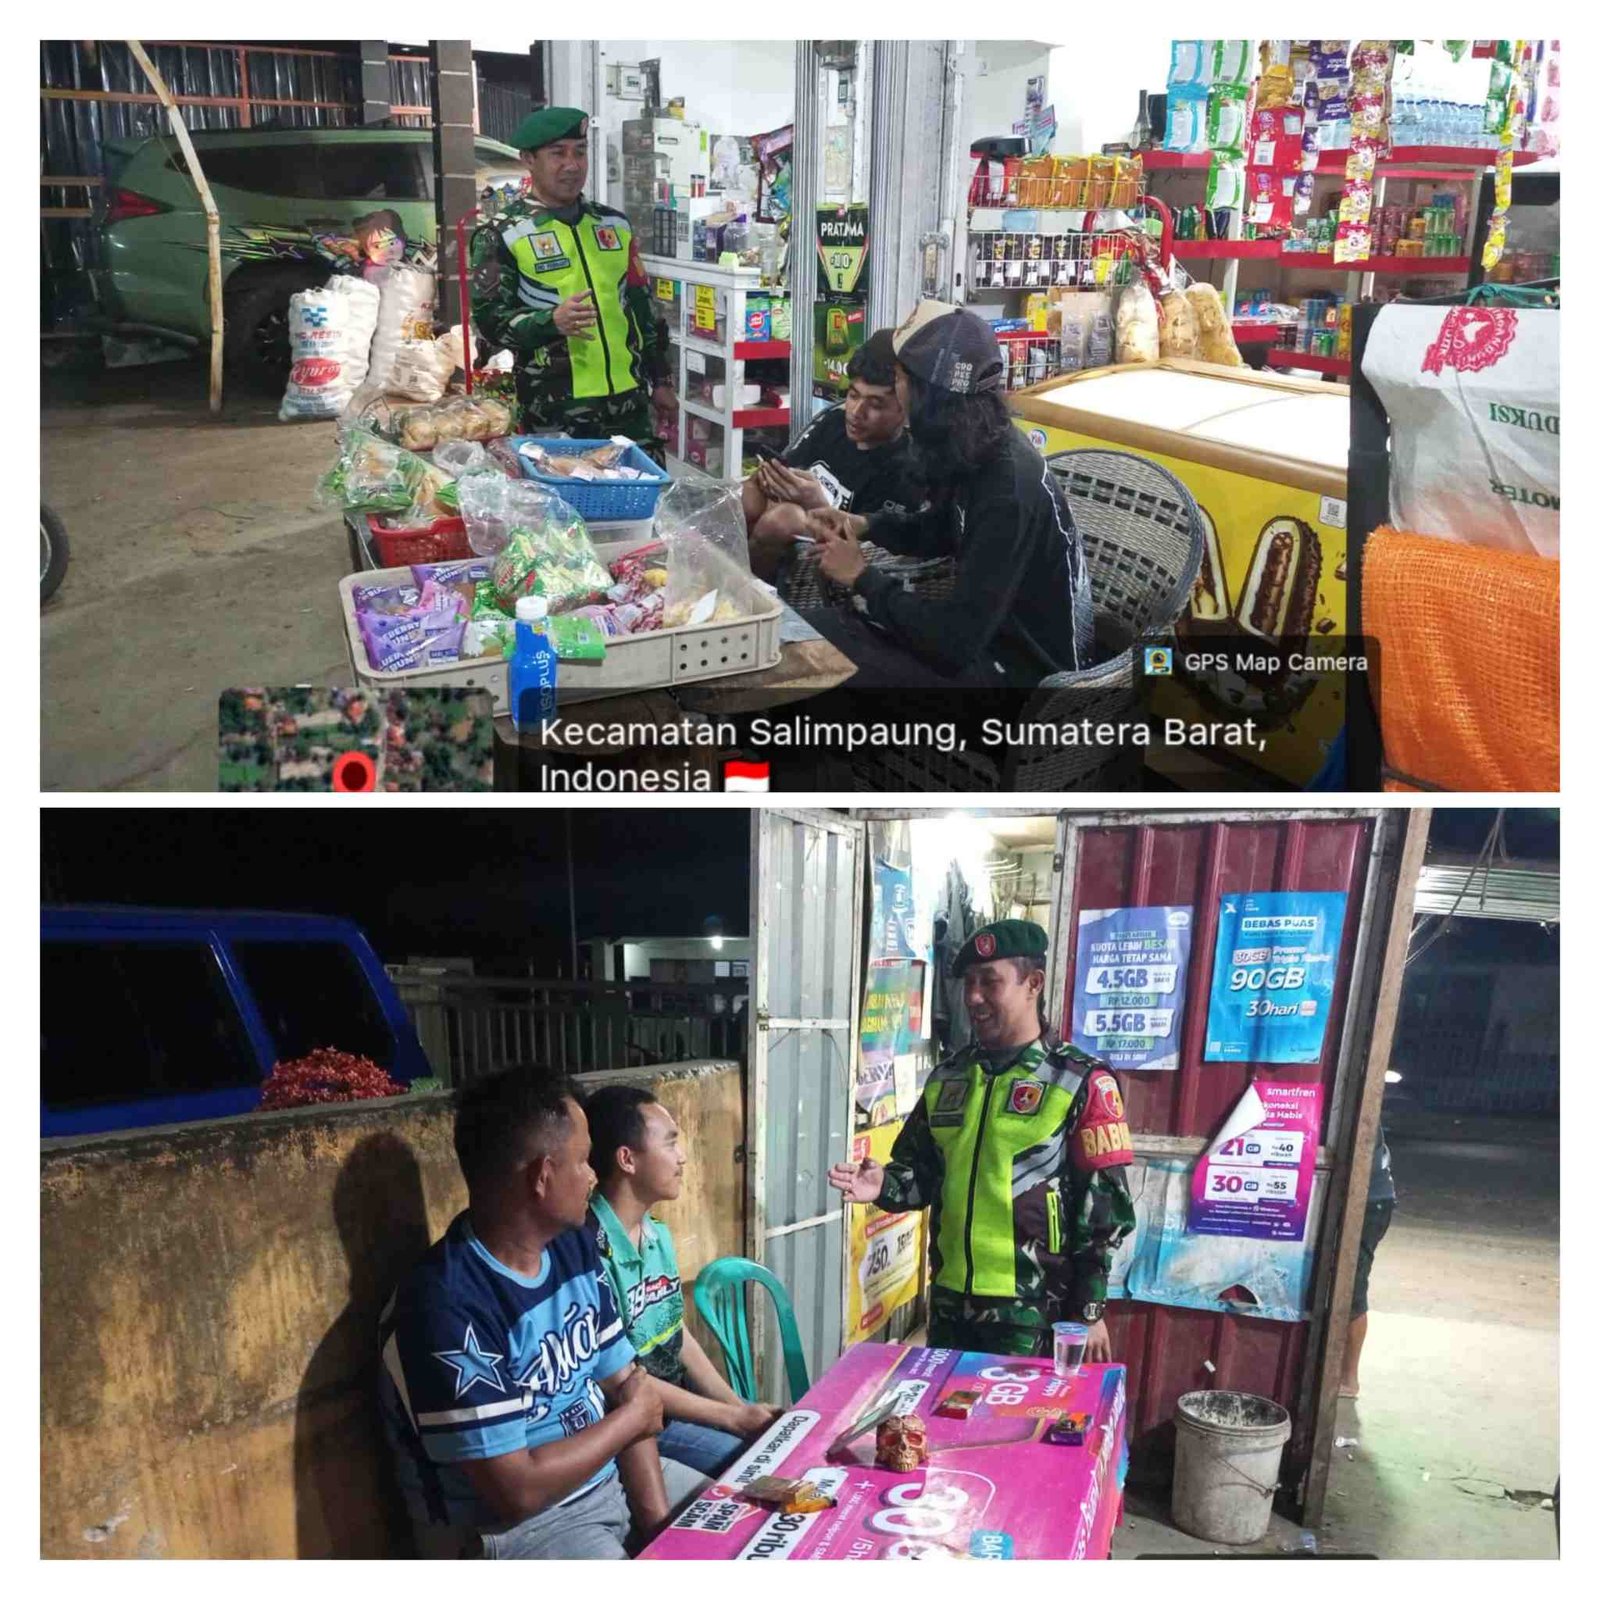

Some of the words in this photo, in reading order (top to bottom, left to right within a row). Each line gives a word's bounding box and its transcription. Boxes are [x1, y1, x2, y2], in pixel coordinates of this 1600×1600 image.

[1244, 919, 1282, 929] BEBAS
[1122, 953, 1147, 963] TETAP
[1097, 968, 1148, 989] 4.5GB
[1229, 966, 1306, 991] 90GB
[1096, 1013, 1146, 1032] 5.5GB
[1266, 1087, 1316, 1098] smartfren
[1219, 1137, 1245, 1156] 21
[1211, 1175, 1243, 1193] 30
[766, 1415, 809, 1454] Dapatkan
[753, 1455, 772, 1464] di
[673, 1501, 713, 1528] SCAM
[701, 1502, 740, 1531] SPAM
